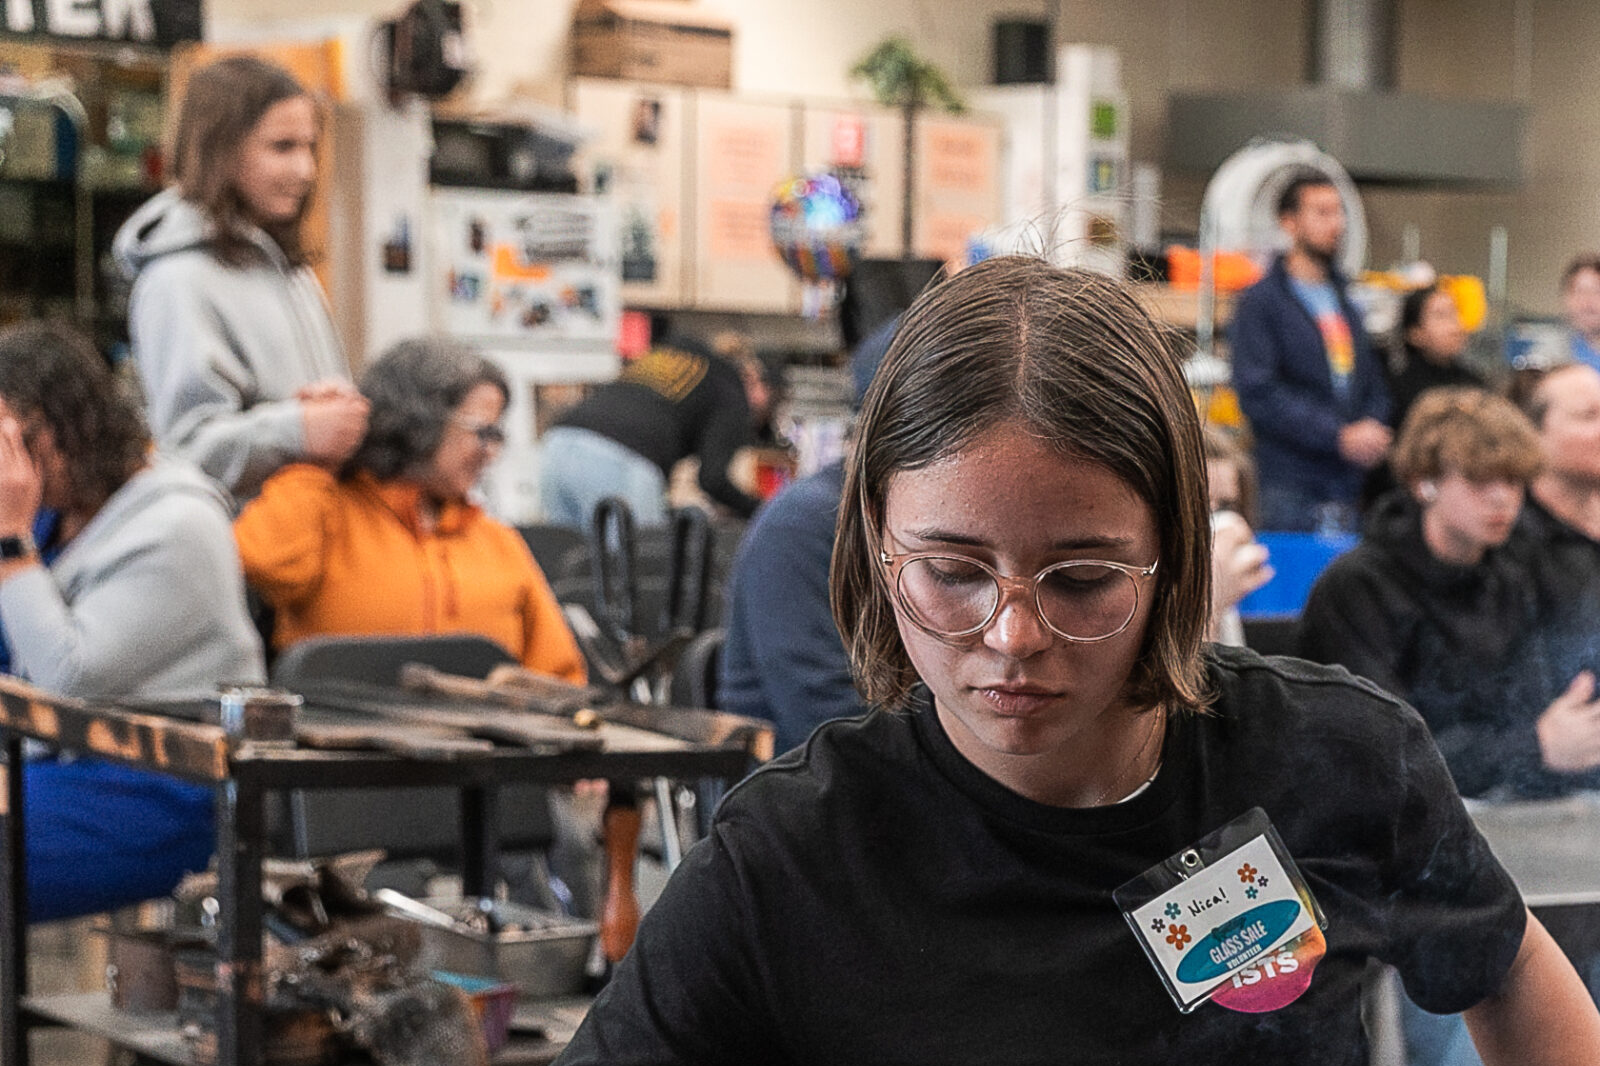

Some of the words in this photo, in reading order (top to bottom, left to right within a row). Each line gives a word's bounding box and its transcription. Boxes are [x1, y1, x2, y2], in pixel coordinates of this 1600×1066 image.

[1188, 887, 1229, 916] Nica!
[1209, 934, 1244, 965] GLASS
[1240, 920, 1268, 946] SALE
[1226, 943, 1262, 970] VOLUNTEER
